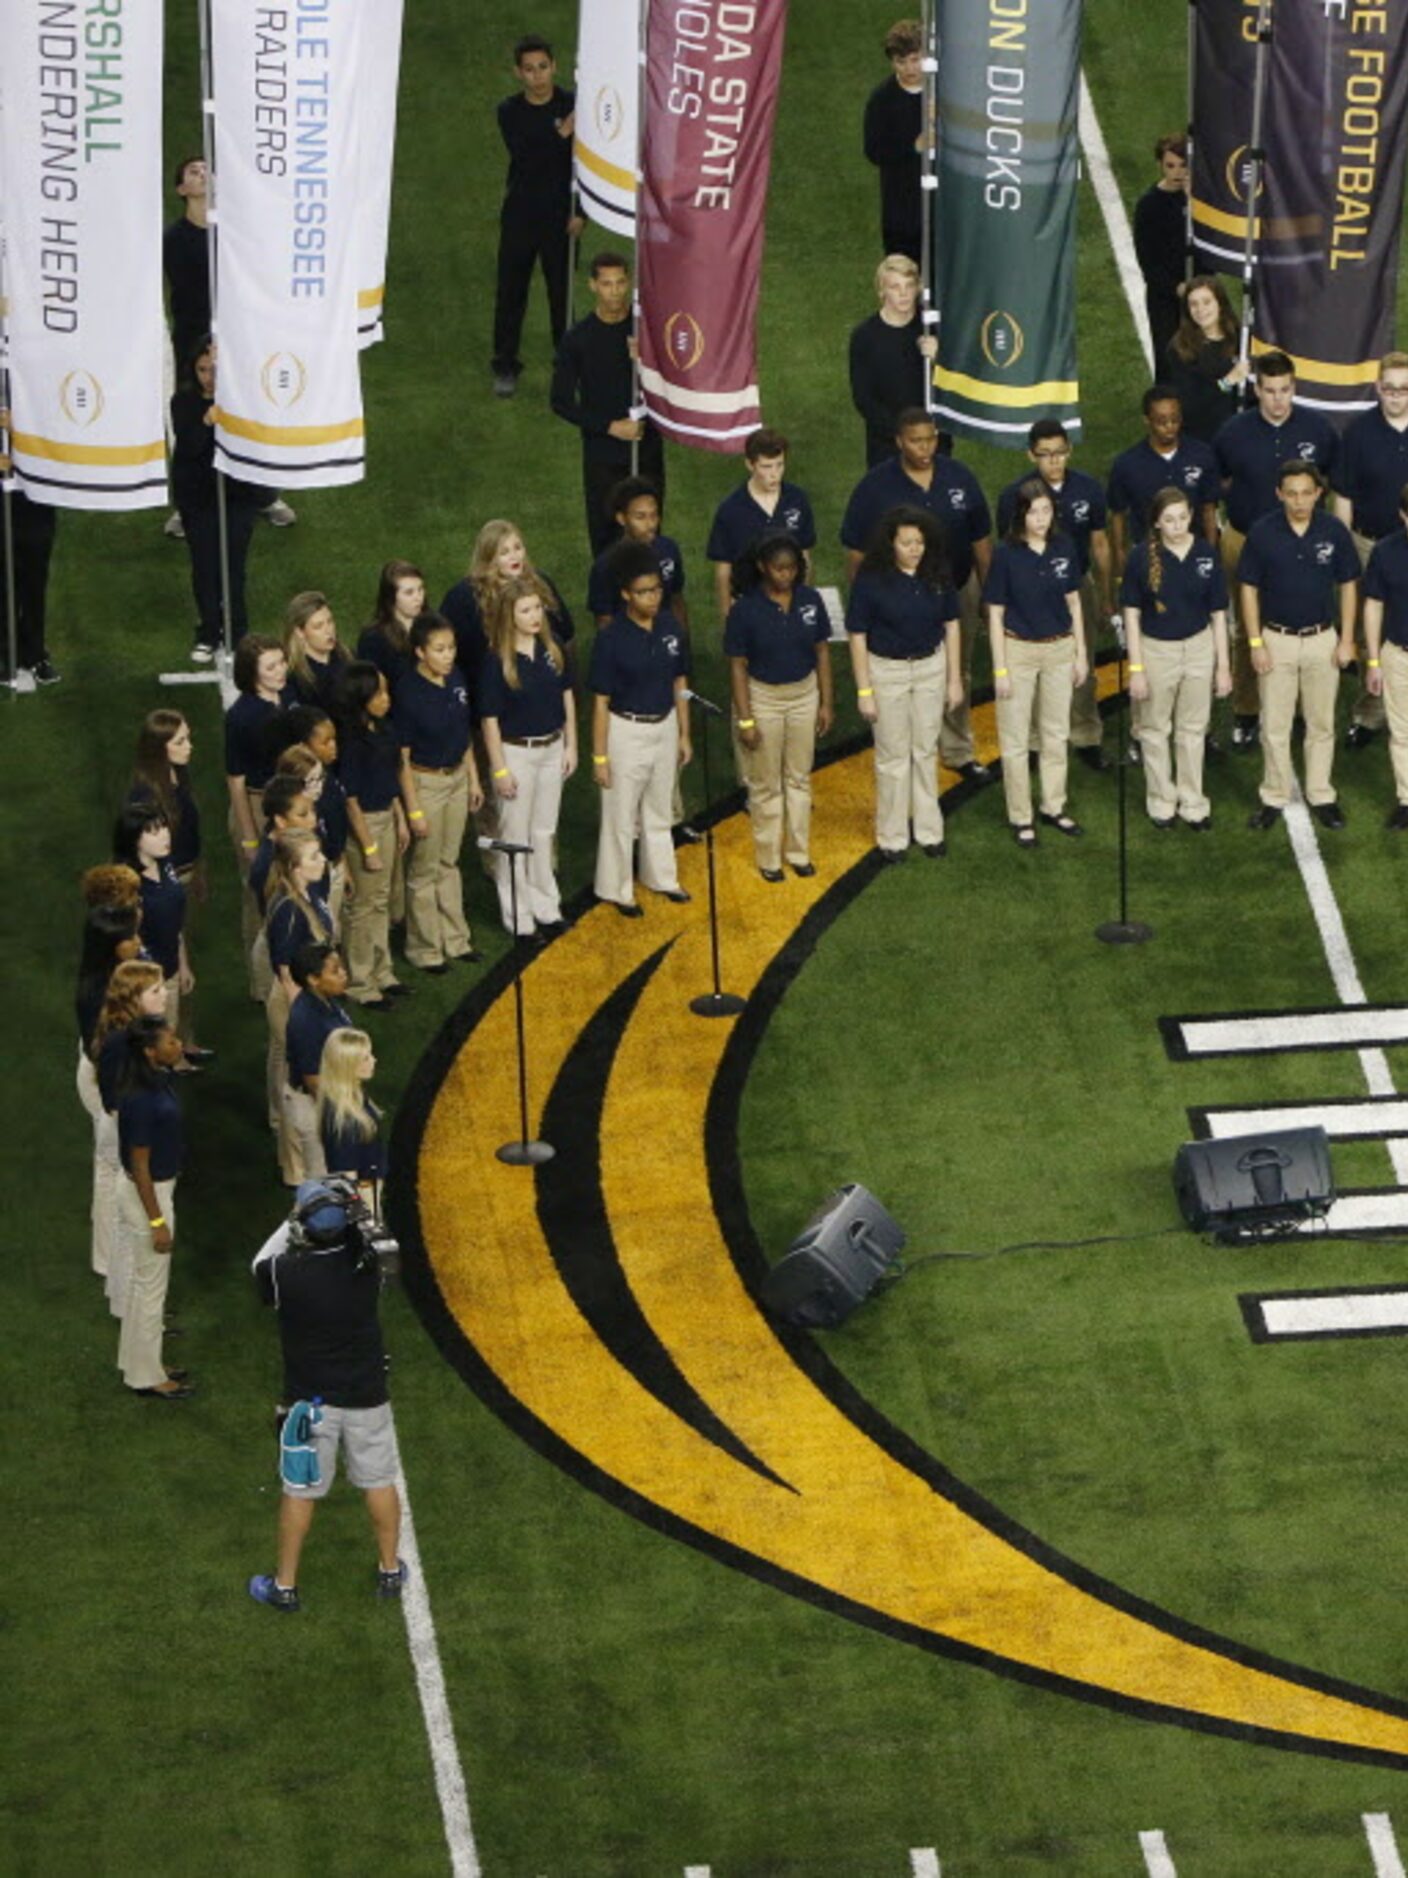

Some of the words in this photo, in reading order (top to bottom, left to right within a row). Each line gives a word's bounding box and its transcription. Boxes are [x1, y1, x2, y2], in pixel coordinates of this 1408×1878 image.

[38, 1, 77, 202] NDERING
[255, 8, 287, 177] RAIDERS
[714, 0, 757, 62] DA
[291, 71, 328, 298] TENNESSEE
[694, 77, 747, 210] STATE
[984, 65, 1024, 211] DUCKS
[1330, 49, 1384, 270] FOOTBALL
[41, 216, 77, 334] HERD
